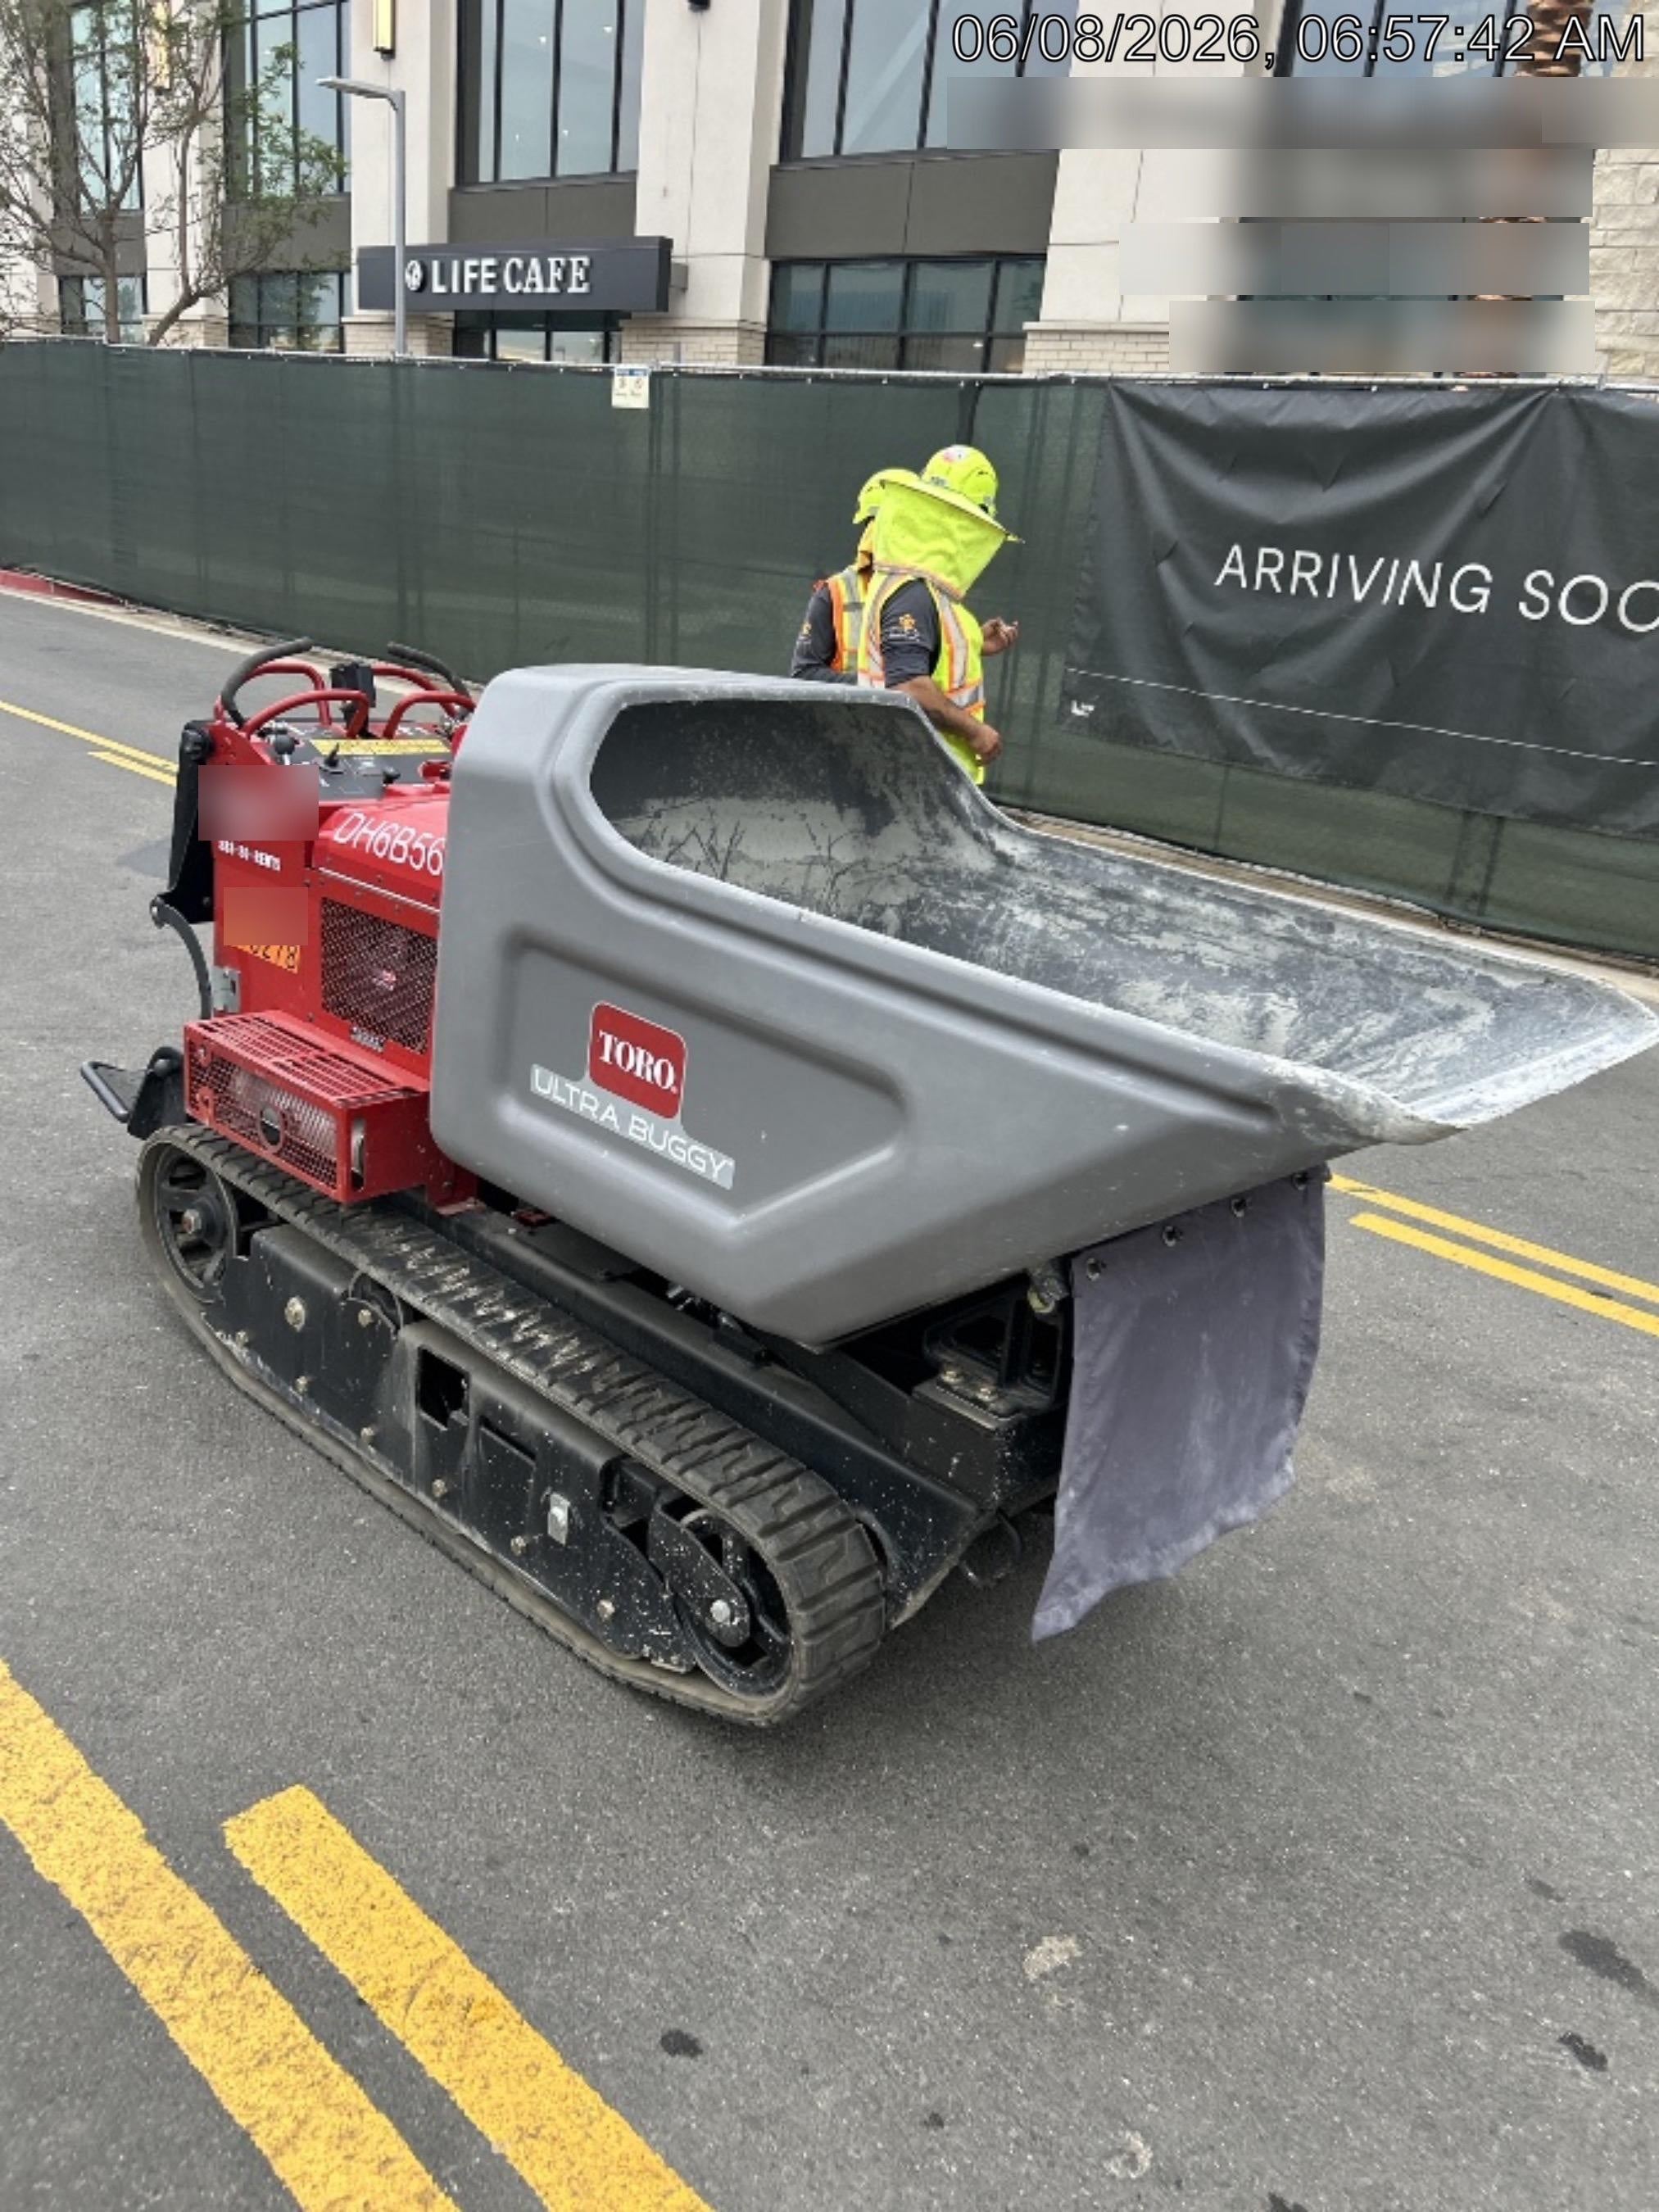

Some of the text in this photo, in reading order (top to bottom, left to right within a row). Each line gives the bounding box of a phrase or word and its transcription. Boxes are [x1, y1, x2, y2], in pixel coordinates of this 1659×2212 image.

[1213, 542, 1494, 614] ARRIVING
[333, 811, 446, 876] DH6B56
[533, 1067, 732, 1180] ULTRA BUGGY
